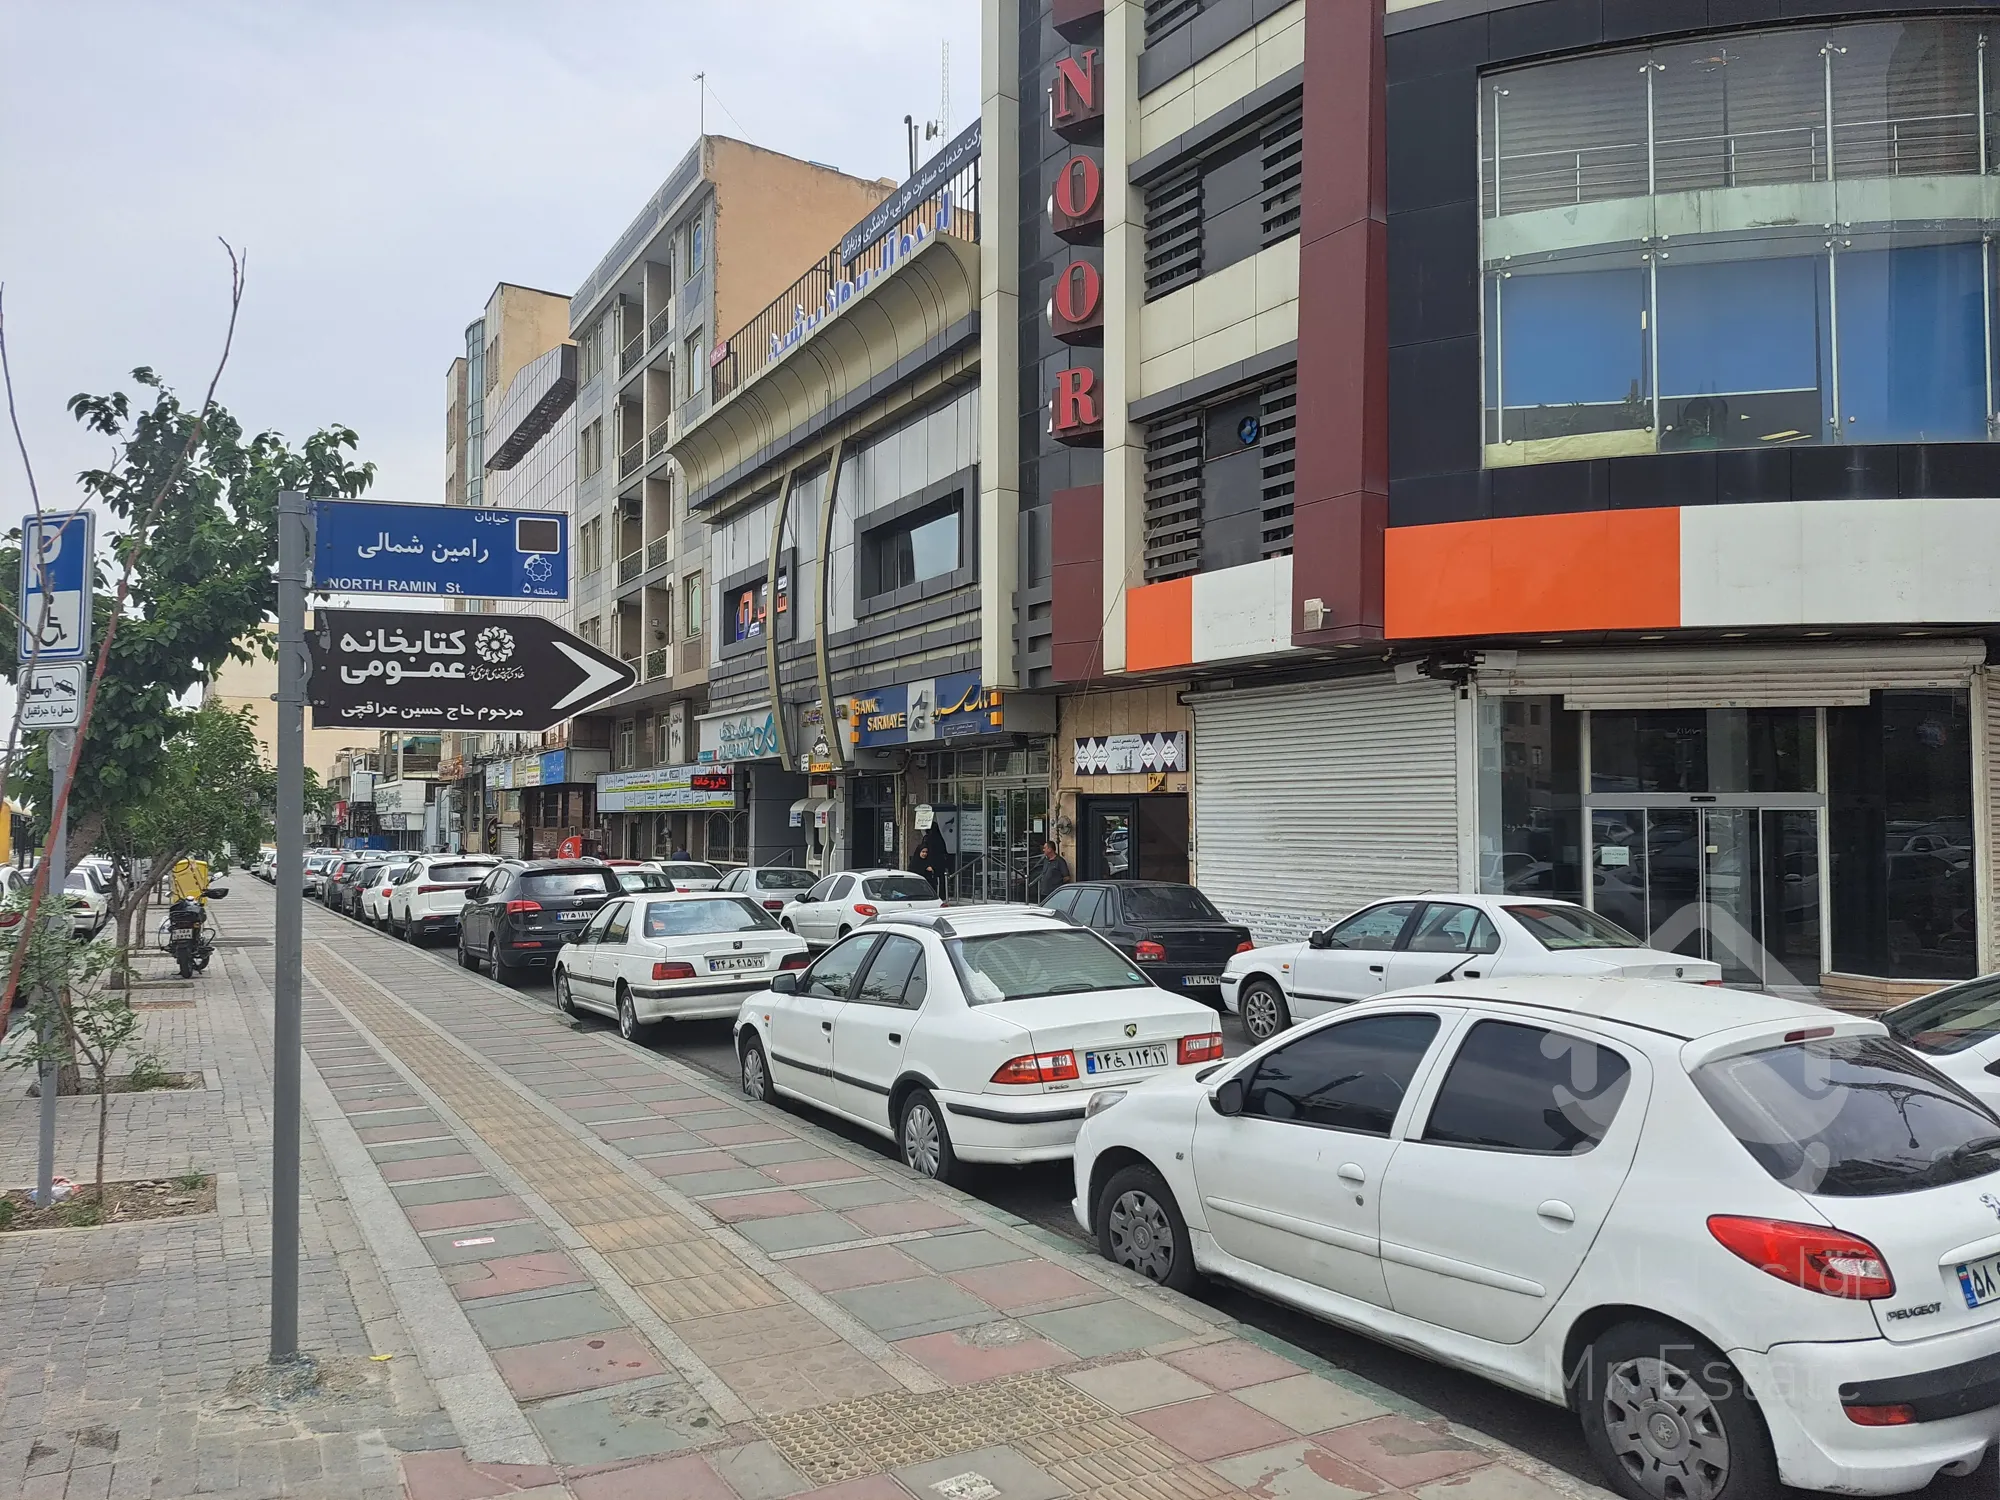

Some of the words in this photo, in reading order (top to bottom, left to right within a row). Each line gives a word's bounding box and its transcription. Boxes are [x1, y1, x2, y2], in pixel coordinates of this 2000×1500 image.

[965, 127, 982, 152] رکت
[938, 144, 964, 173] خدمات
[912, 169, 938, 198] مسافرت
[863, 203, 890, 244] گردشگری
[1055, 48, 1099, 432] NOOR
[474, 511, 509, 526] خیابان
[357, 531, 424, 559] شمالی
[431, 538, 490, 564] رامین
[329, 577, 383, 592] NORTH
[389, 579, 437, 593] RAMIN
[445, 581, 464, 594] St.
[522, 582, 531, 595] ۵
[533, 587, 559, 597] منطقه
[340, 627, 466, 663] کتابخانه
[339, 659, 466, 685] عمومی
[24, 704, 50, 721] جرثقیل
[50, 703, 57, 716] با
[57, 702, 74, 718] حمل
[341, 701, 398, 719] عراقچی
[401, 706, 443, 719] حسین
[446, 703, 475, 721] حاج
[477, 703, 524, 720] مرحوم
[854, 698, 877, 716] BANK
[866, 711, 907, 732] SARMAYE
[693, 776, 727, 789] داروخانه
[1096, 1053, 1111, 1070] ۱۴
[1128, 1049, 1149, 1067] ۱۱۴
[1153, 1050, 1166, 1064] ۱۱
[1886, 1301, 1942, 1322] PEUGEOT
